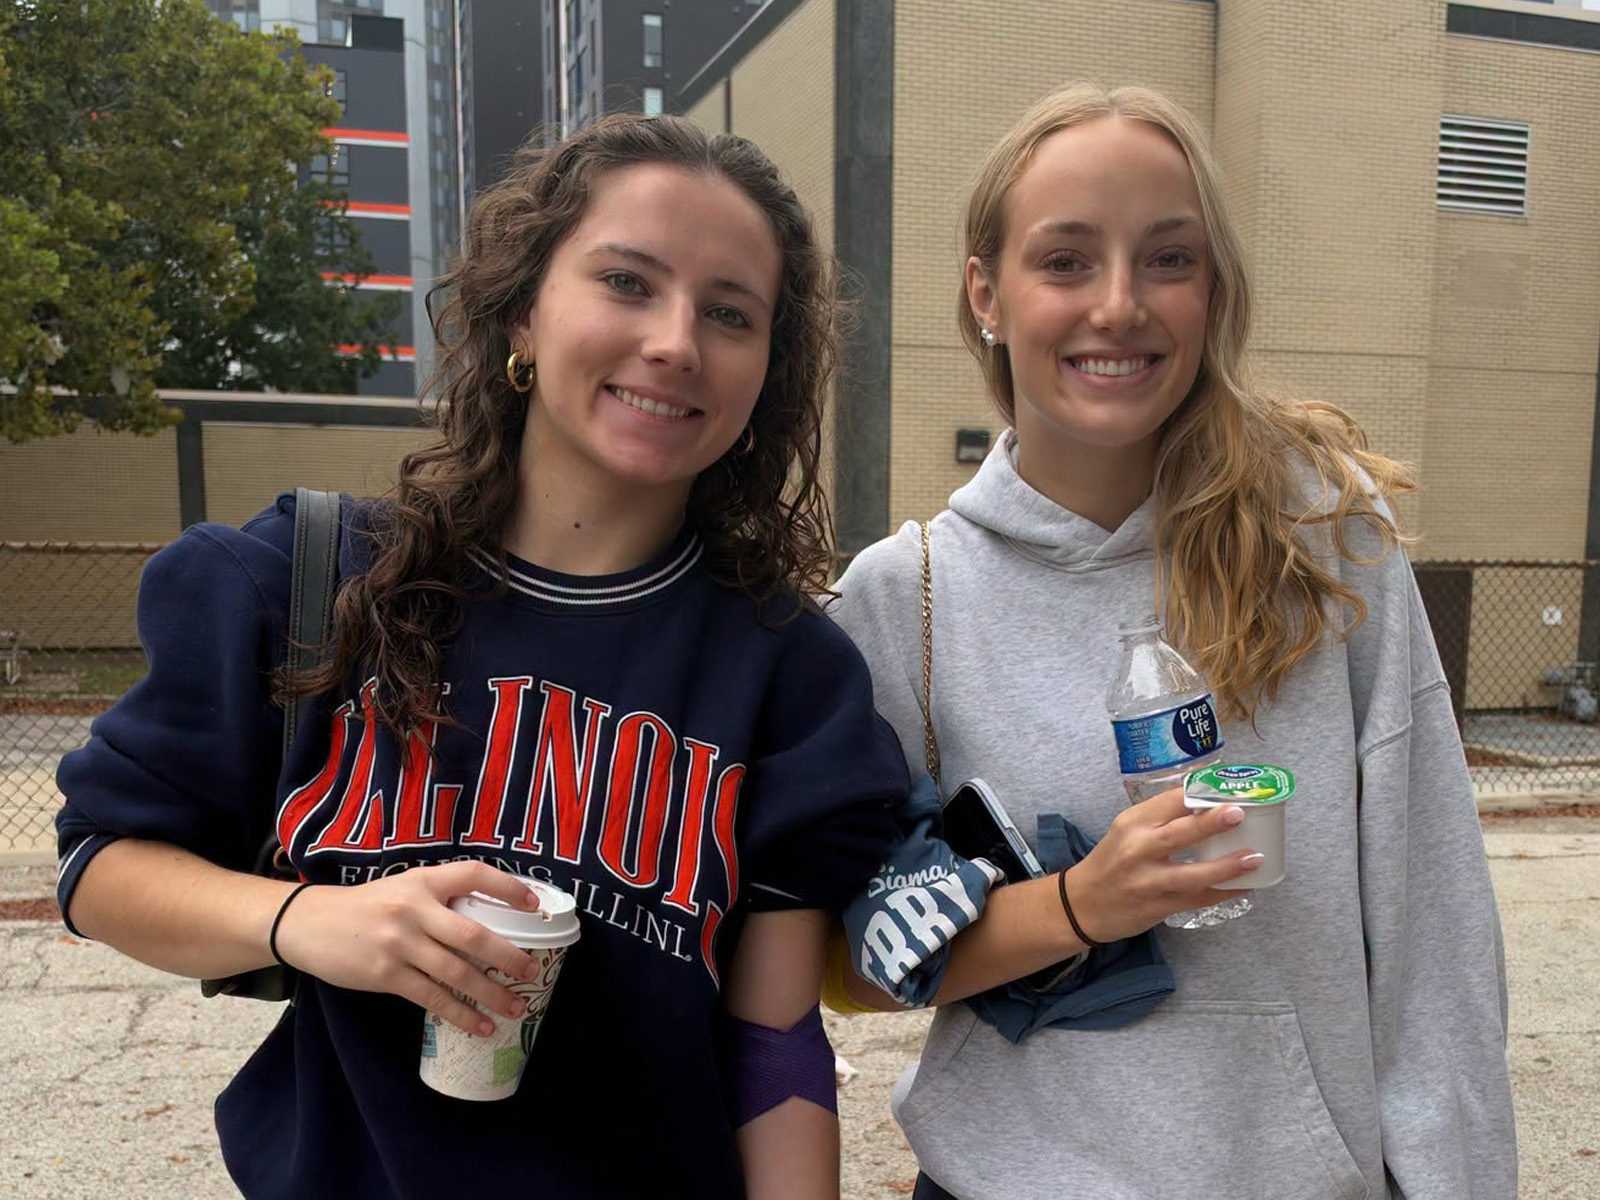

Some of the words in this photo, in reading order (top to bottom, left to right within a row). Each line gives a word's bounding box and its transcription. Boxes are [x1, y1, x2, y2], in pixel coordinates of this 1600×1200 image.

[1179, 703, 1209, 724] Pure
[1187, 718, 1211, 738] Life
[1219, 781, 1259, 790] APPLE
[571, 877, 689, 960] ILLINI
